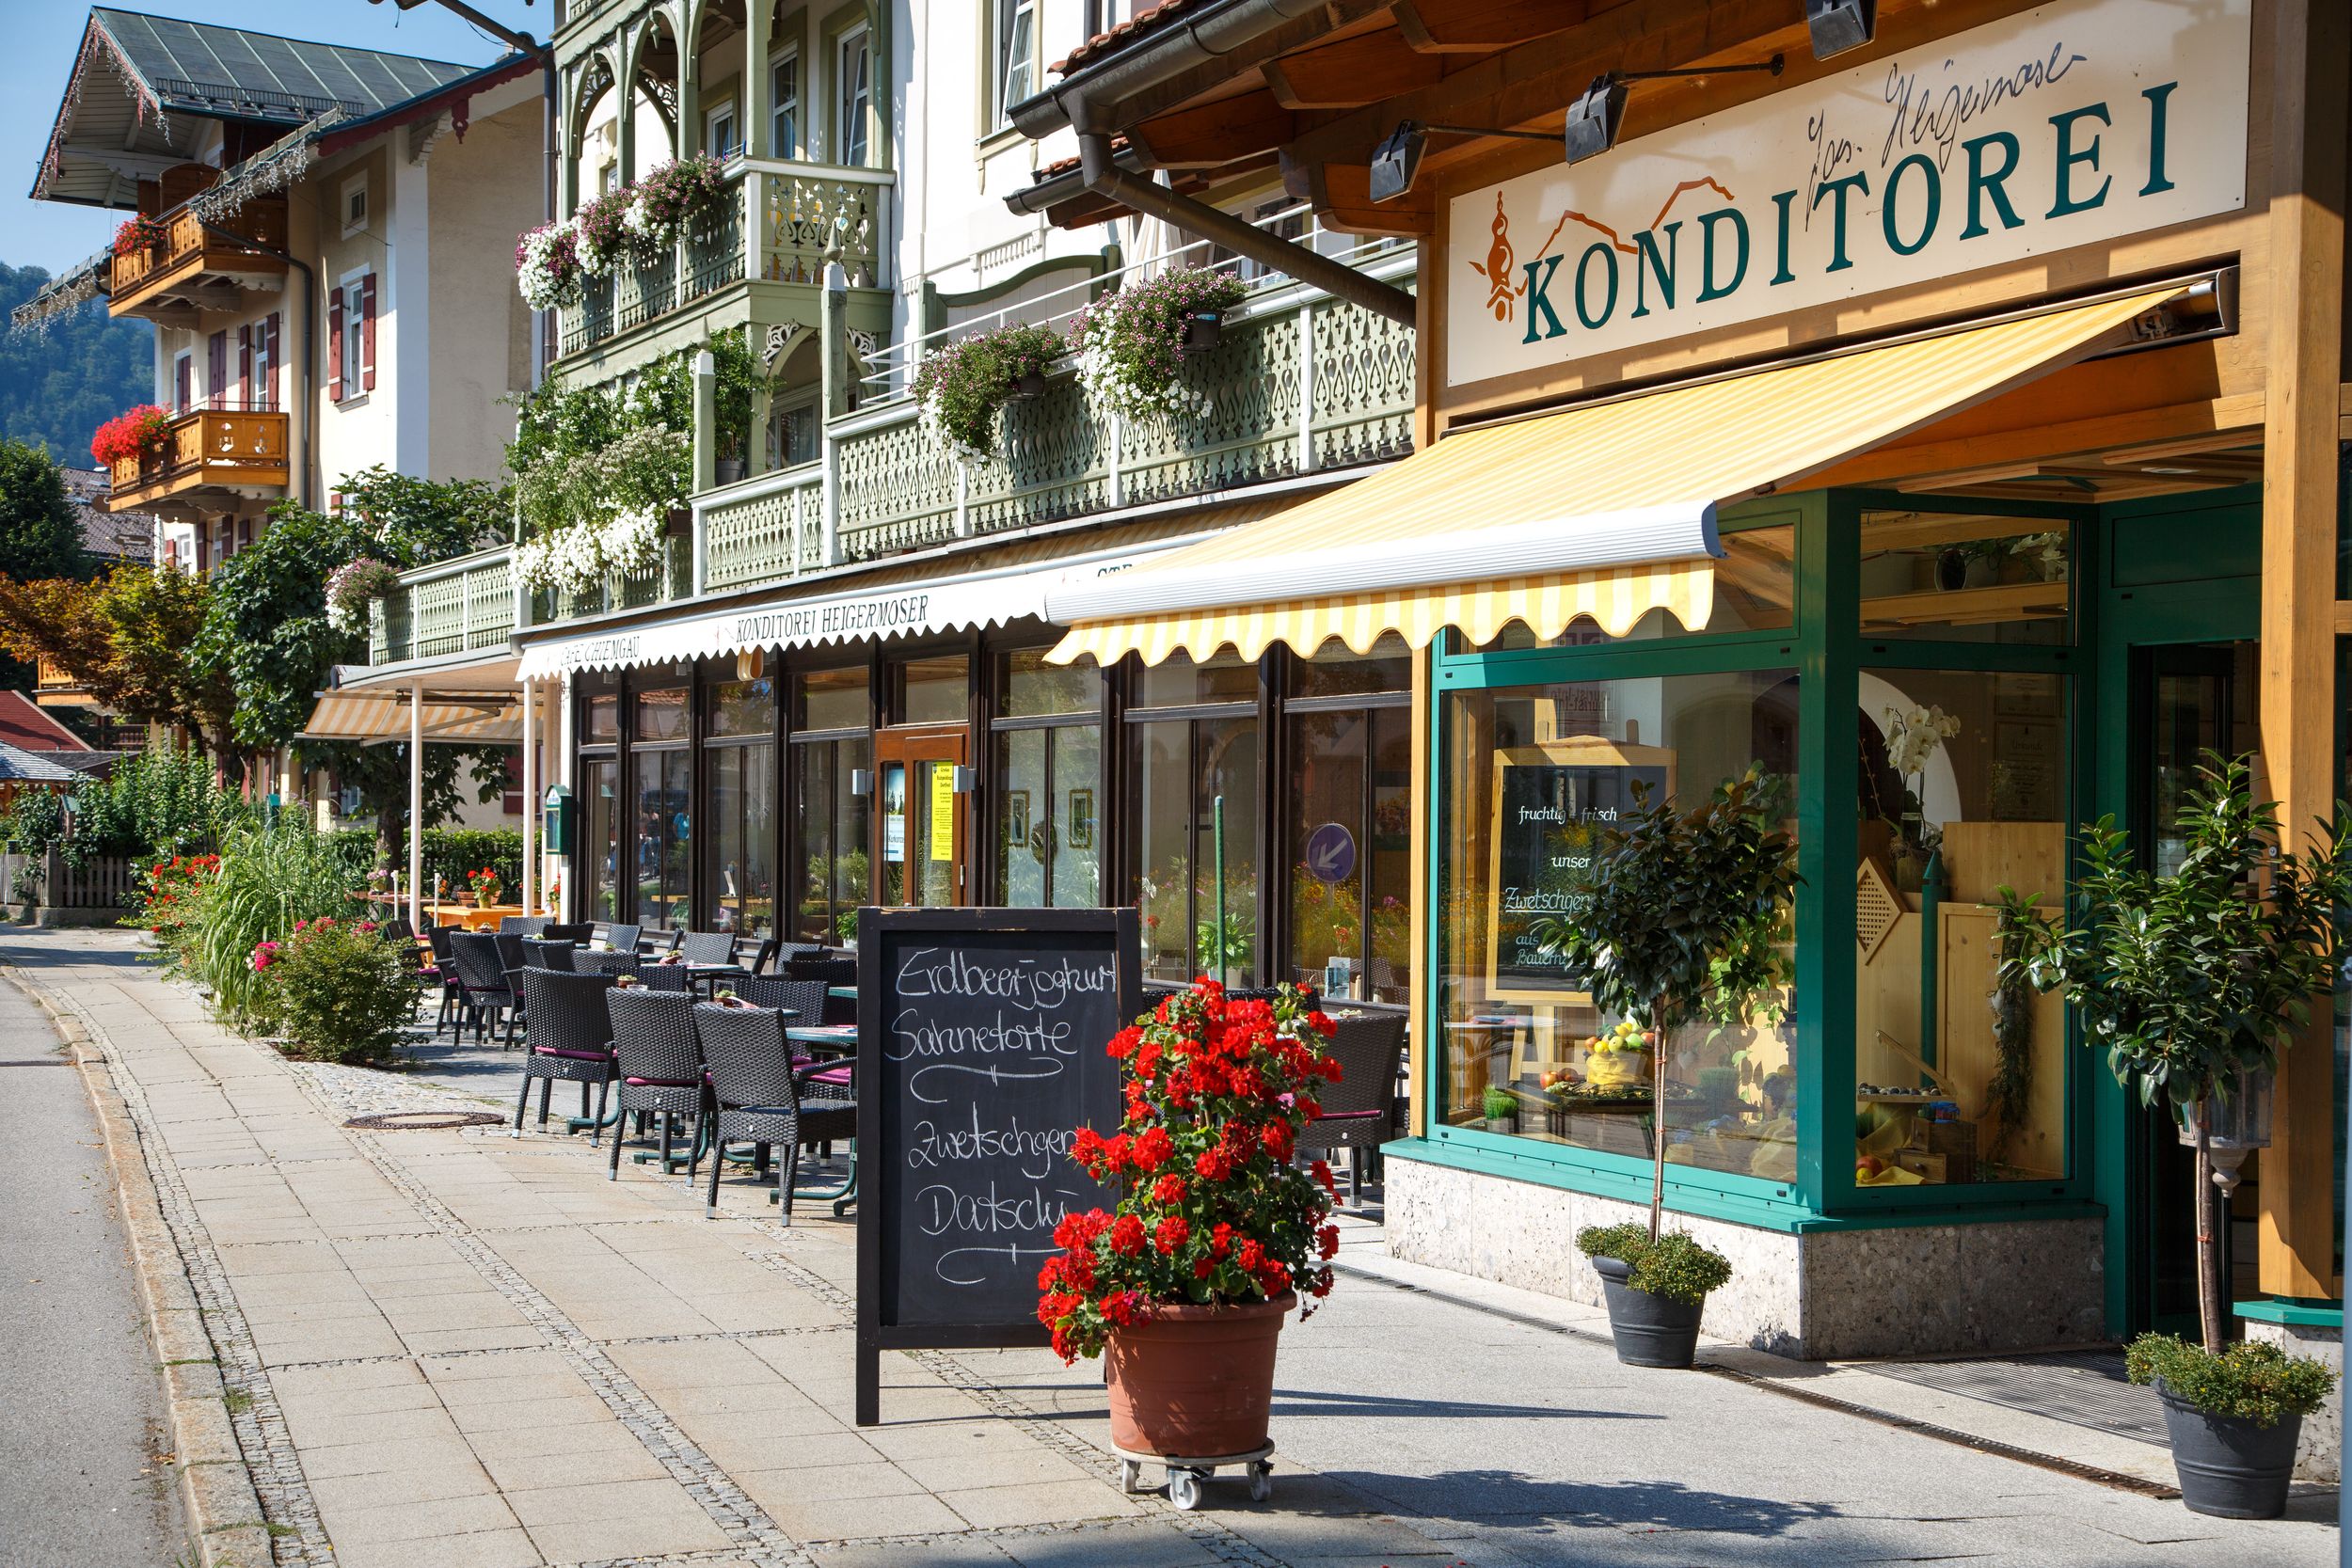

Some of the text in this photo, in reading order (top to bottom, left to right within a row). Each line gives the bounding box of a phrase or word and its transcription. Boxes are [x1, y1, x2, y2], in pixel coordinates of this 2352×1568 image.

[1522, 81, 2178, 345] KONDITOREI
[737, 594, 928, 642] KONDITOREI HEIGERMOSER
[584, 636, 640, 662] CHIEMGAU
[1518, 805, 1566, 825] fruchtig
[1581, 806, 1617, 826] frisch
[1551, 856, 1591, 868] unser
[1516, 935, 1539, 945] aus
[884, 1008, 1078, 1060] Sahnetorte
